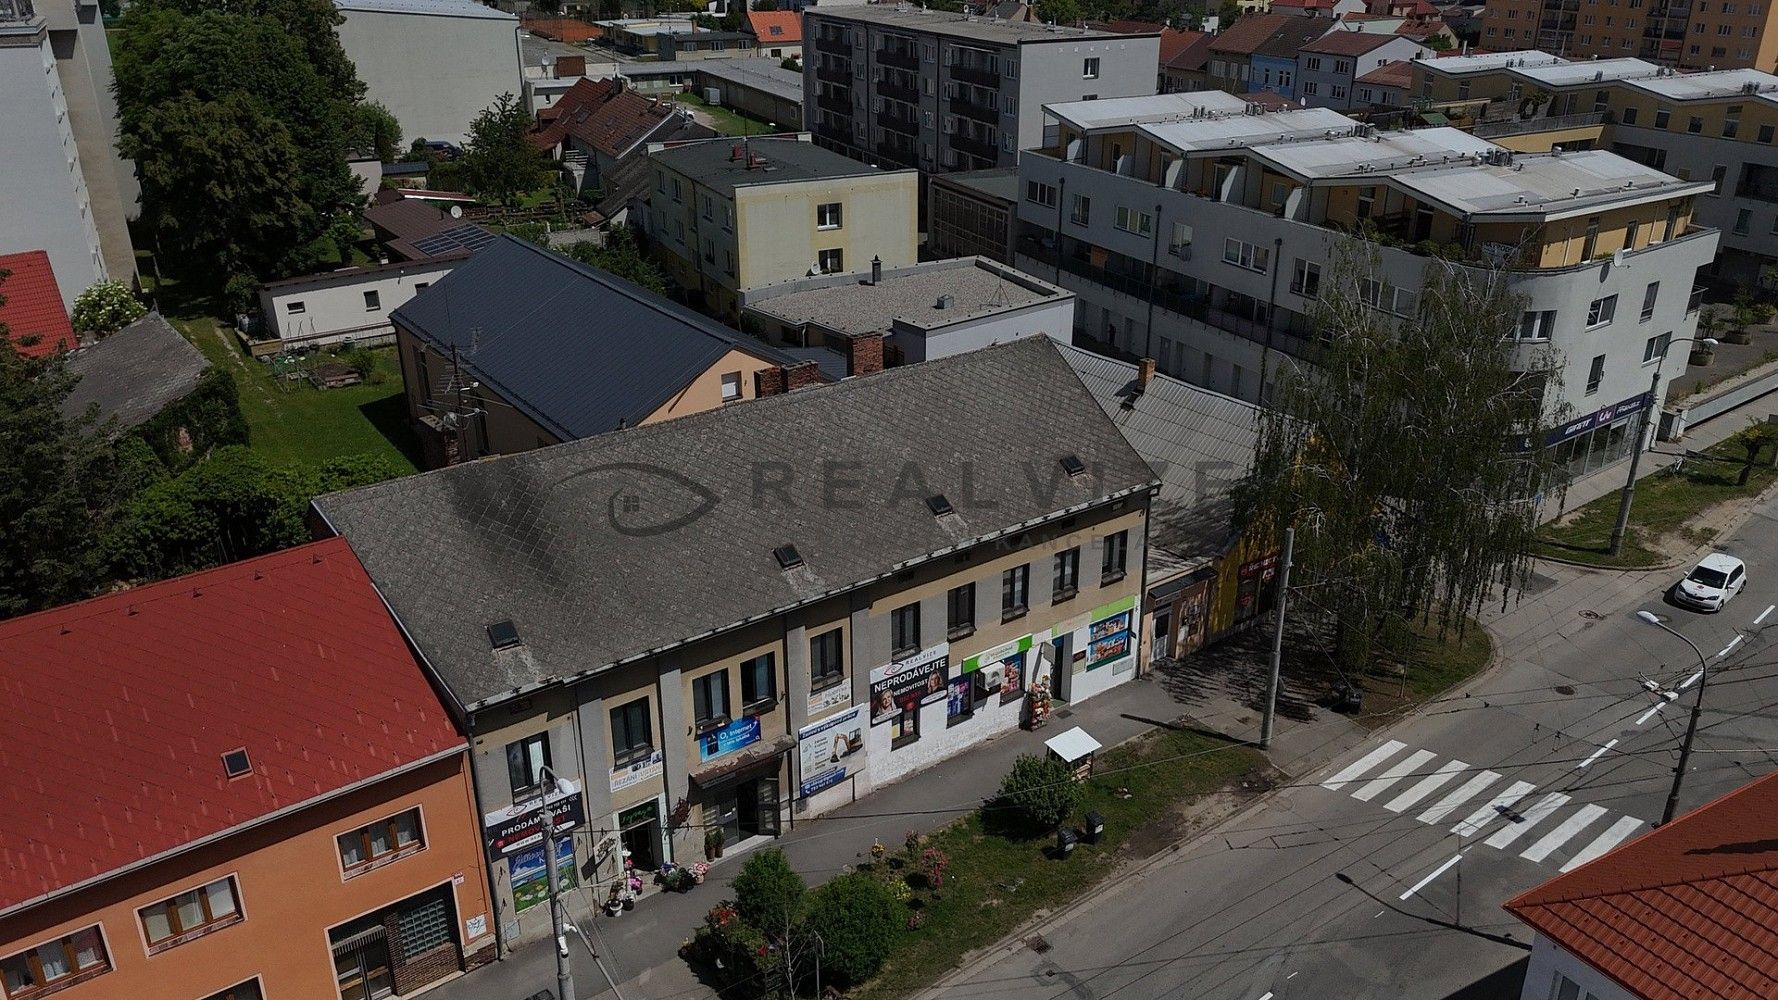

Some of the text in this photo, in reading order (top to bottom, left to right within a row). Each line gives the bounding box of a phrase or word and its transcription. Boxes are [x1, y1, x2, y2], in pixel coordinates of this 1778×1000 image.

[874, 658, 946, 693] NEPRODÁVEJTE
[894, 679, 928, 696] NEMOVITOST
[729, 723, 751, 737] Internet
[501, 815, 541, 837] PRODÁM
